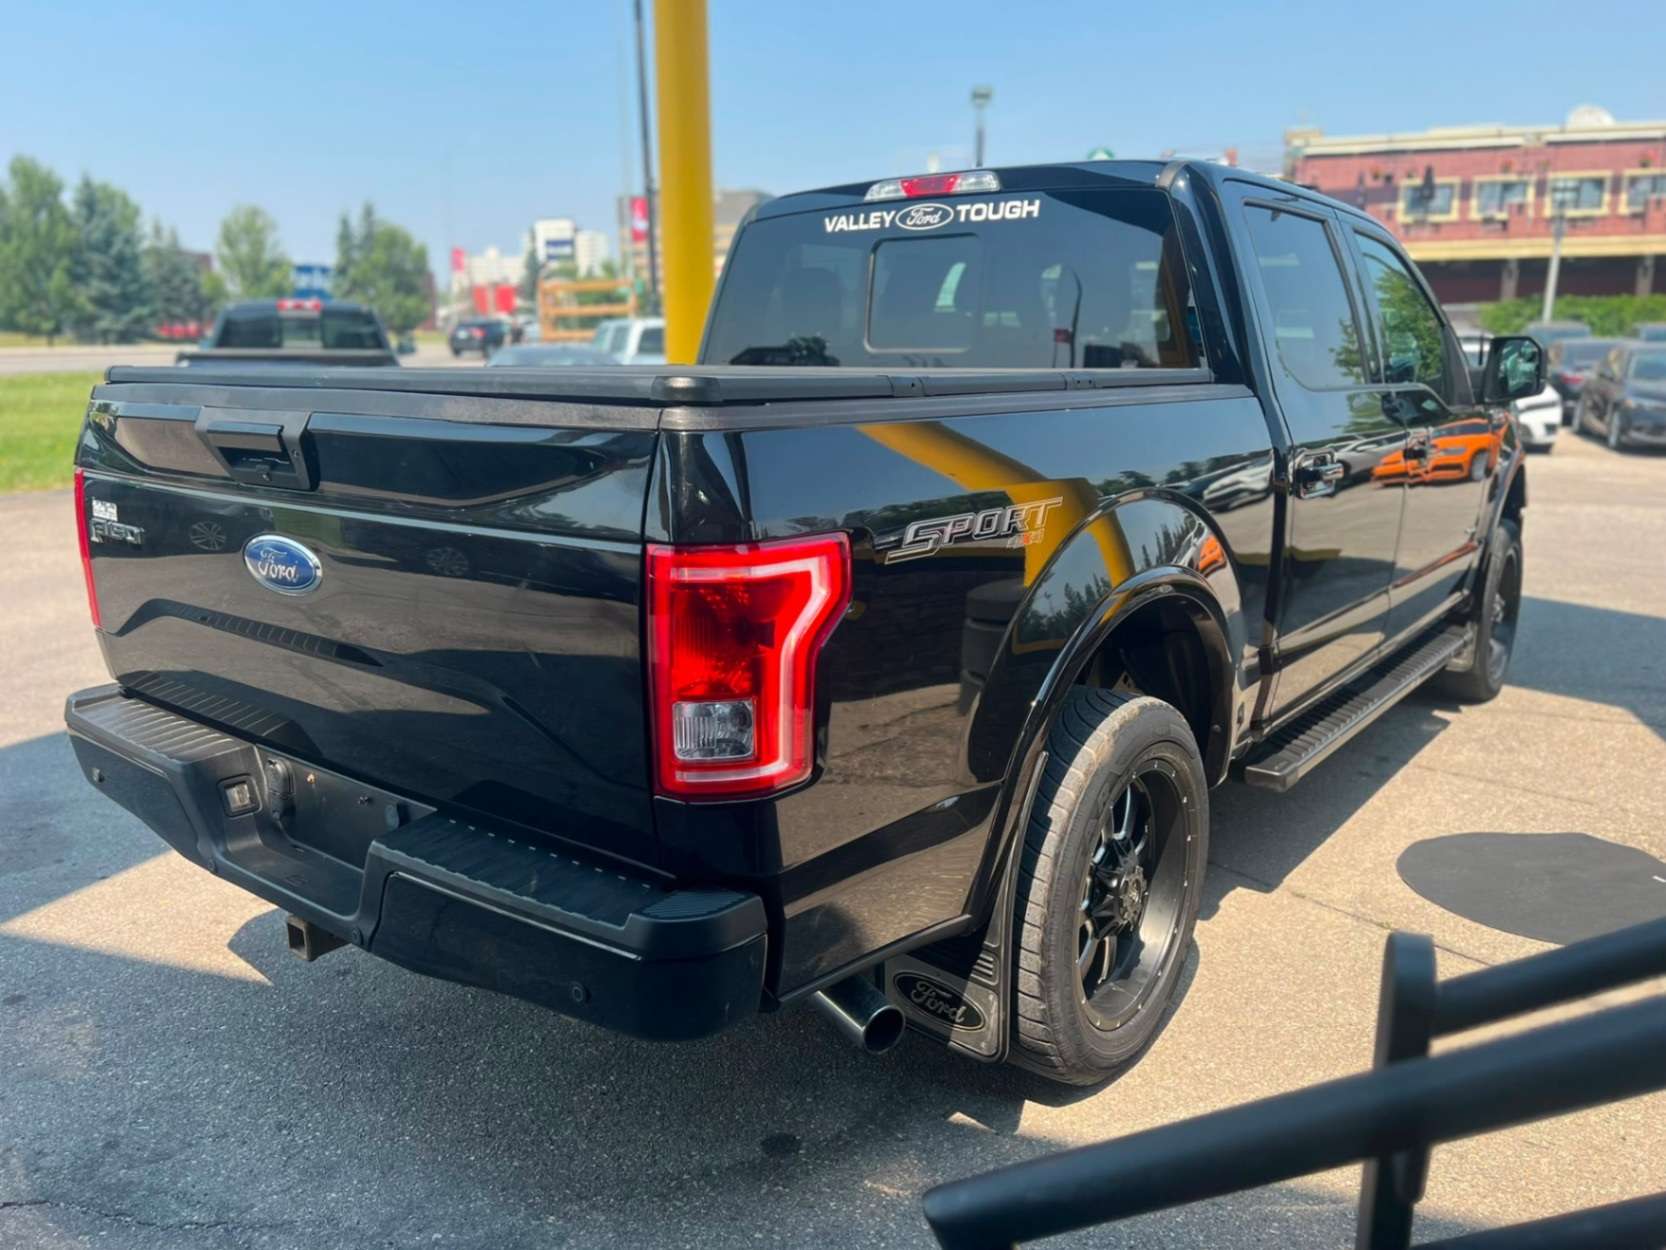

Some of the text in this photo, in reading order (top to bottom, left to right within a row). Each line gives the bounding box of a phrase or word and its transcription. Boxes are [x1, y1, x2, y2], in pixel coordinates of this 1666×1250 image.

[824, 200, 1041, 233] VALLEY Ford TOUGH
[884, 496, 1064, 565] SPORT
[257, 546, 297, 584] Ford
[911, 980, 967, 1024] Ford
